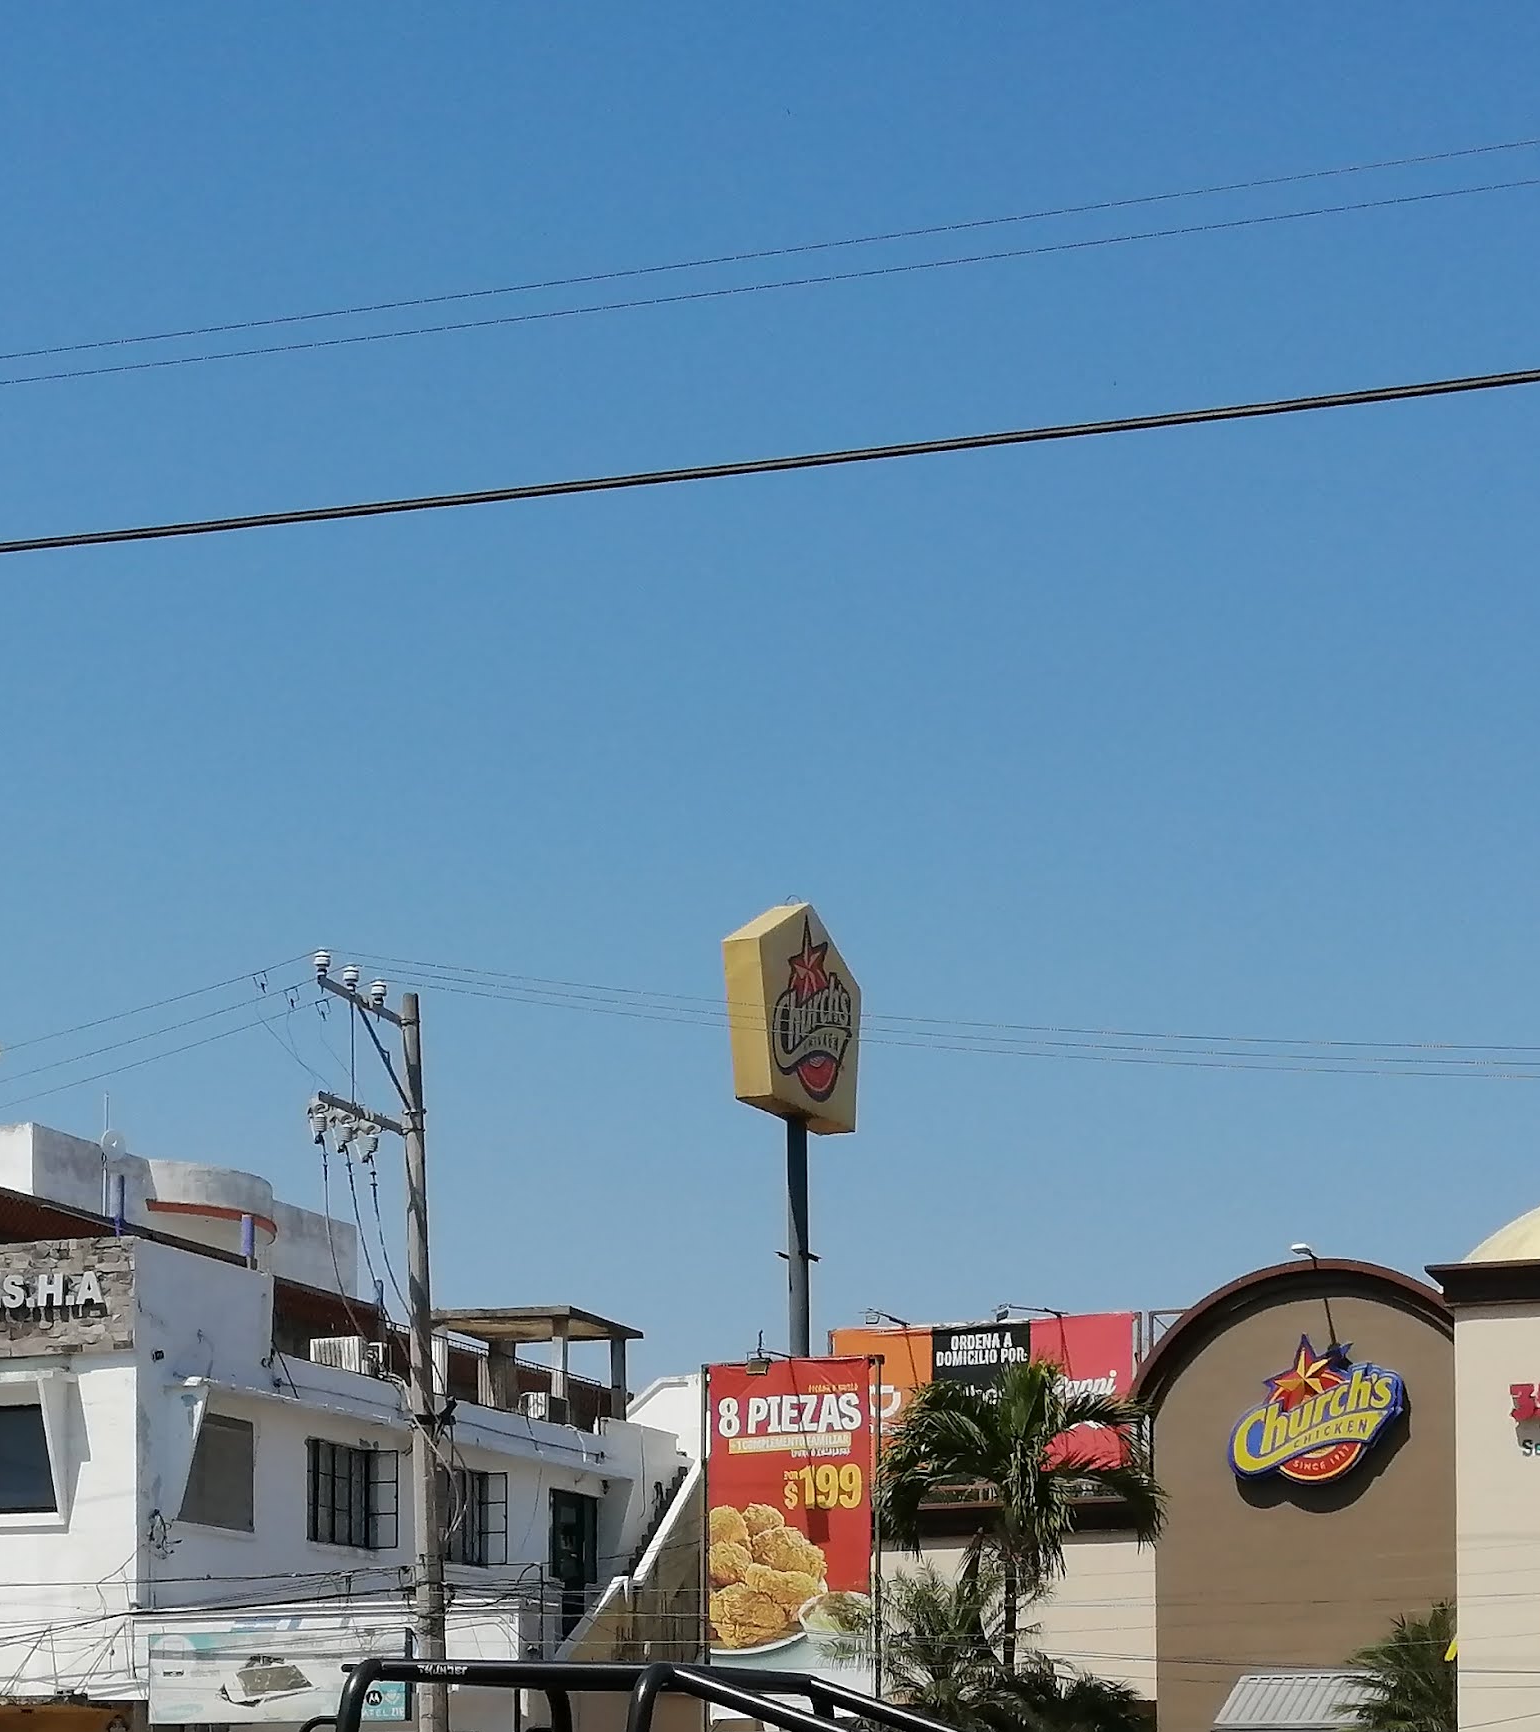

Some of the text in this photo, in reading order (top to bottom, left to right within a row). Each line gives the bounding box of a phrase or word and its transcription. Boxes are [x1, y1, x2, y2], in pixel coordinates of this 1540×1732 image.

[951, 1333, 1013, 1350] ORDENA A
[936, 1350, 997, 1367] DOMICILIO
[718, 1392, 862, 1438] 8 PIEZAS
[1234, 1369, 1393, 1473] Church's
[1293, 1418, 1368, 1449] CHICKEN
